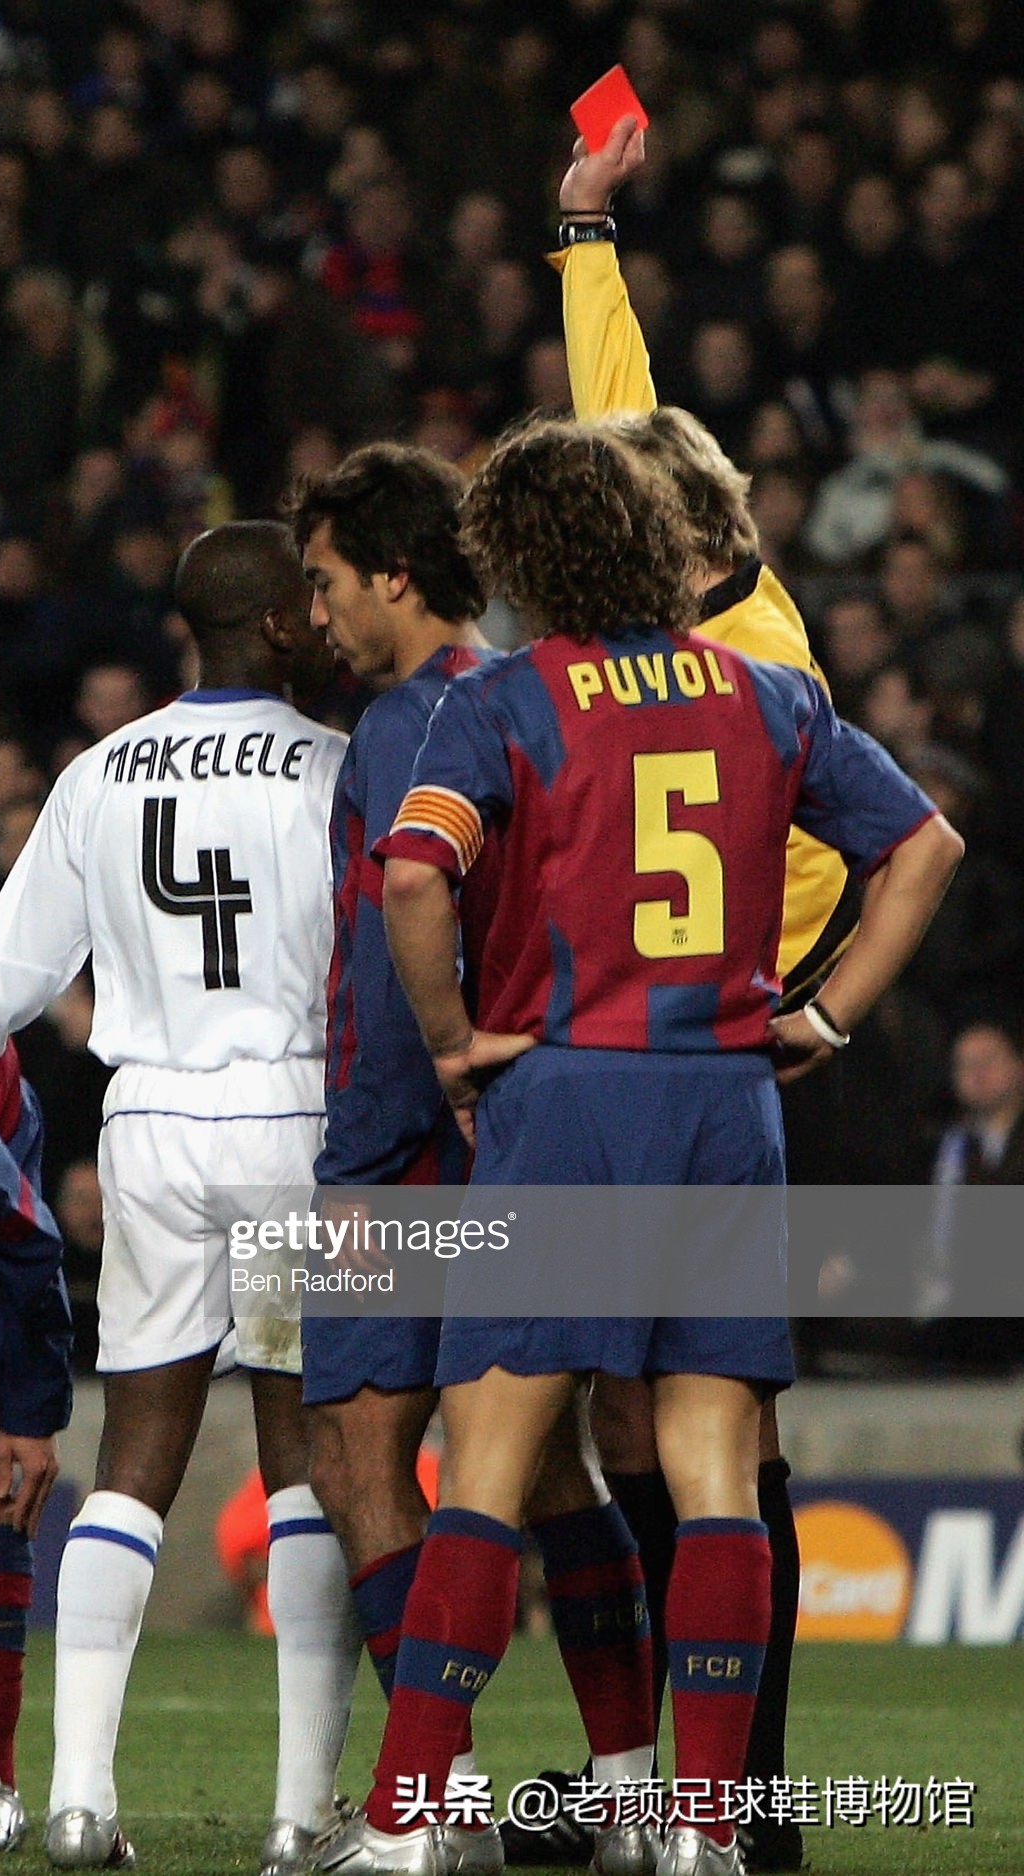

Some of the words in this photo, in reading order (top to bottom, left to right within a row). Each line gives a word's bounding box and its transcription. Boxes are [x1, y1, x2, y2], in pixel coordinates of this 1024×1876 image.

[567, 649, 734, 711] PUYOL
[103, 732, 313, 784] MAKELELE
[633, 749, 725, 959] 5
[142, 797, 253, 991] 4
[441, 1660, 489, 1691] FCB
[687, 1654, 742, 1678] FCB
